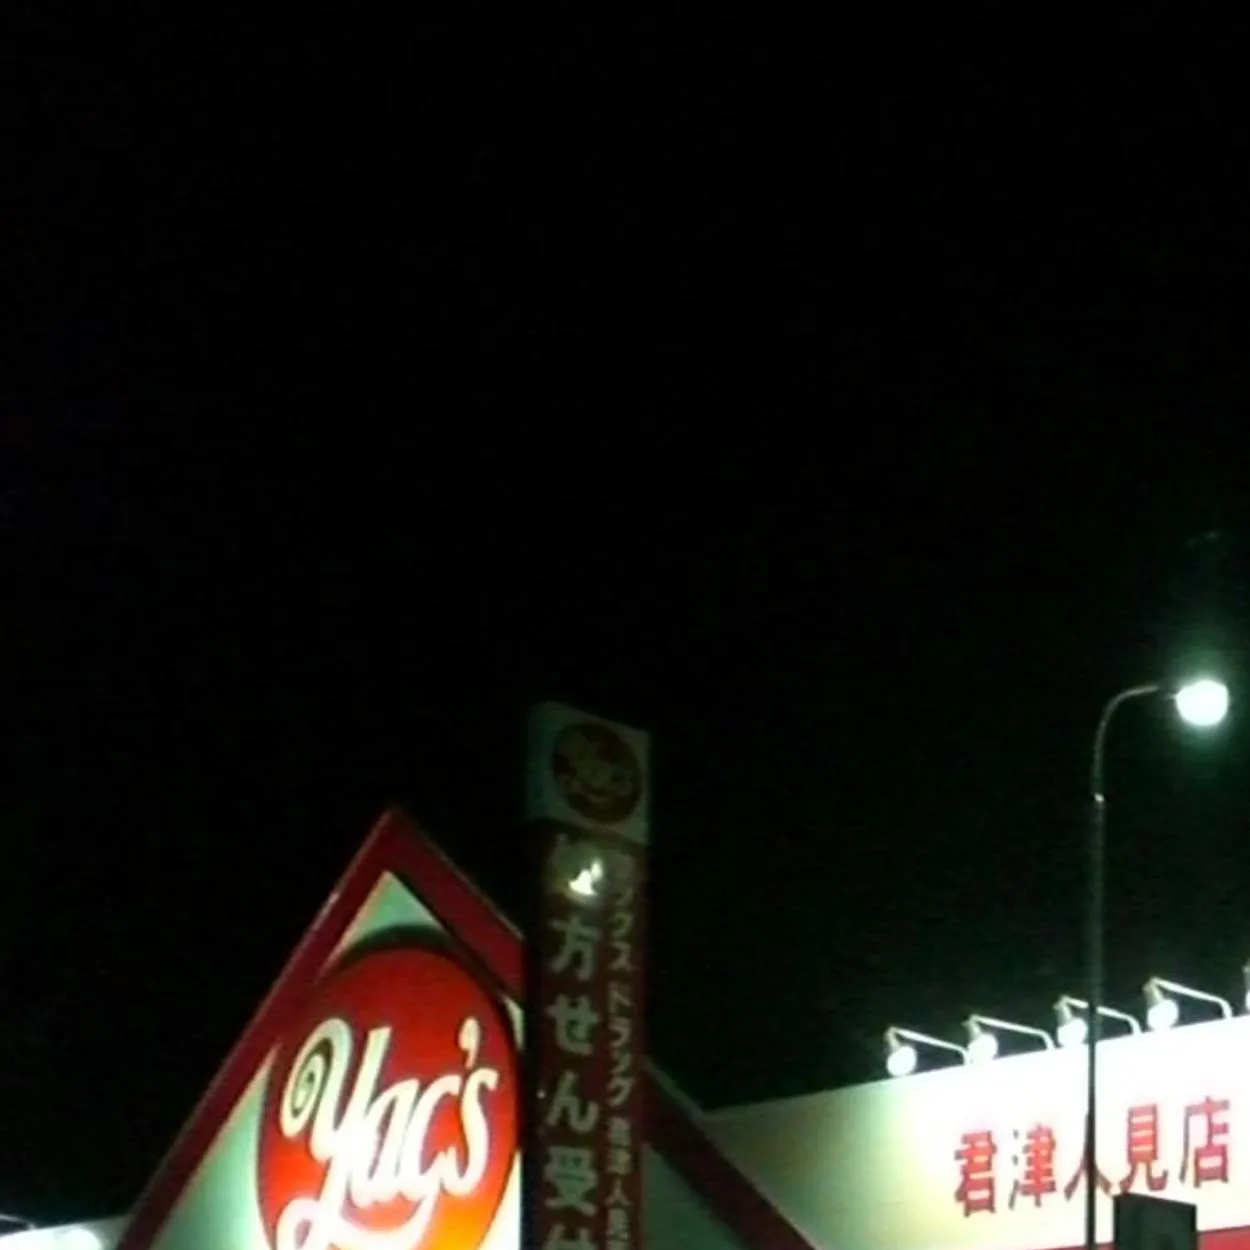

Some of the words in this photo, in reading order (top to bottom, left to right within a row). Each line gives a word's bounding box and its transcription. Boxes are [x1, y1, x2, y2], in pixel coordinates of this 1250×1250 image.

[954, 1096, 1230, 1217] 君津人見店
